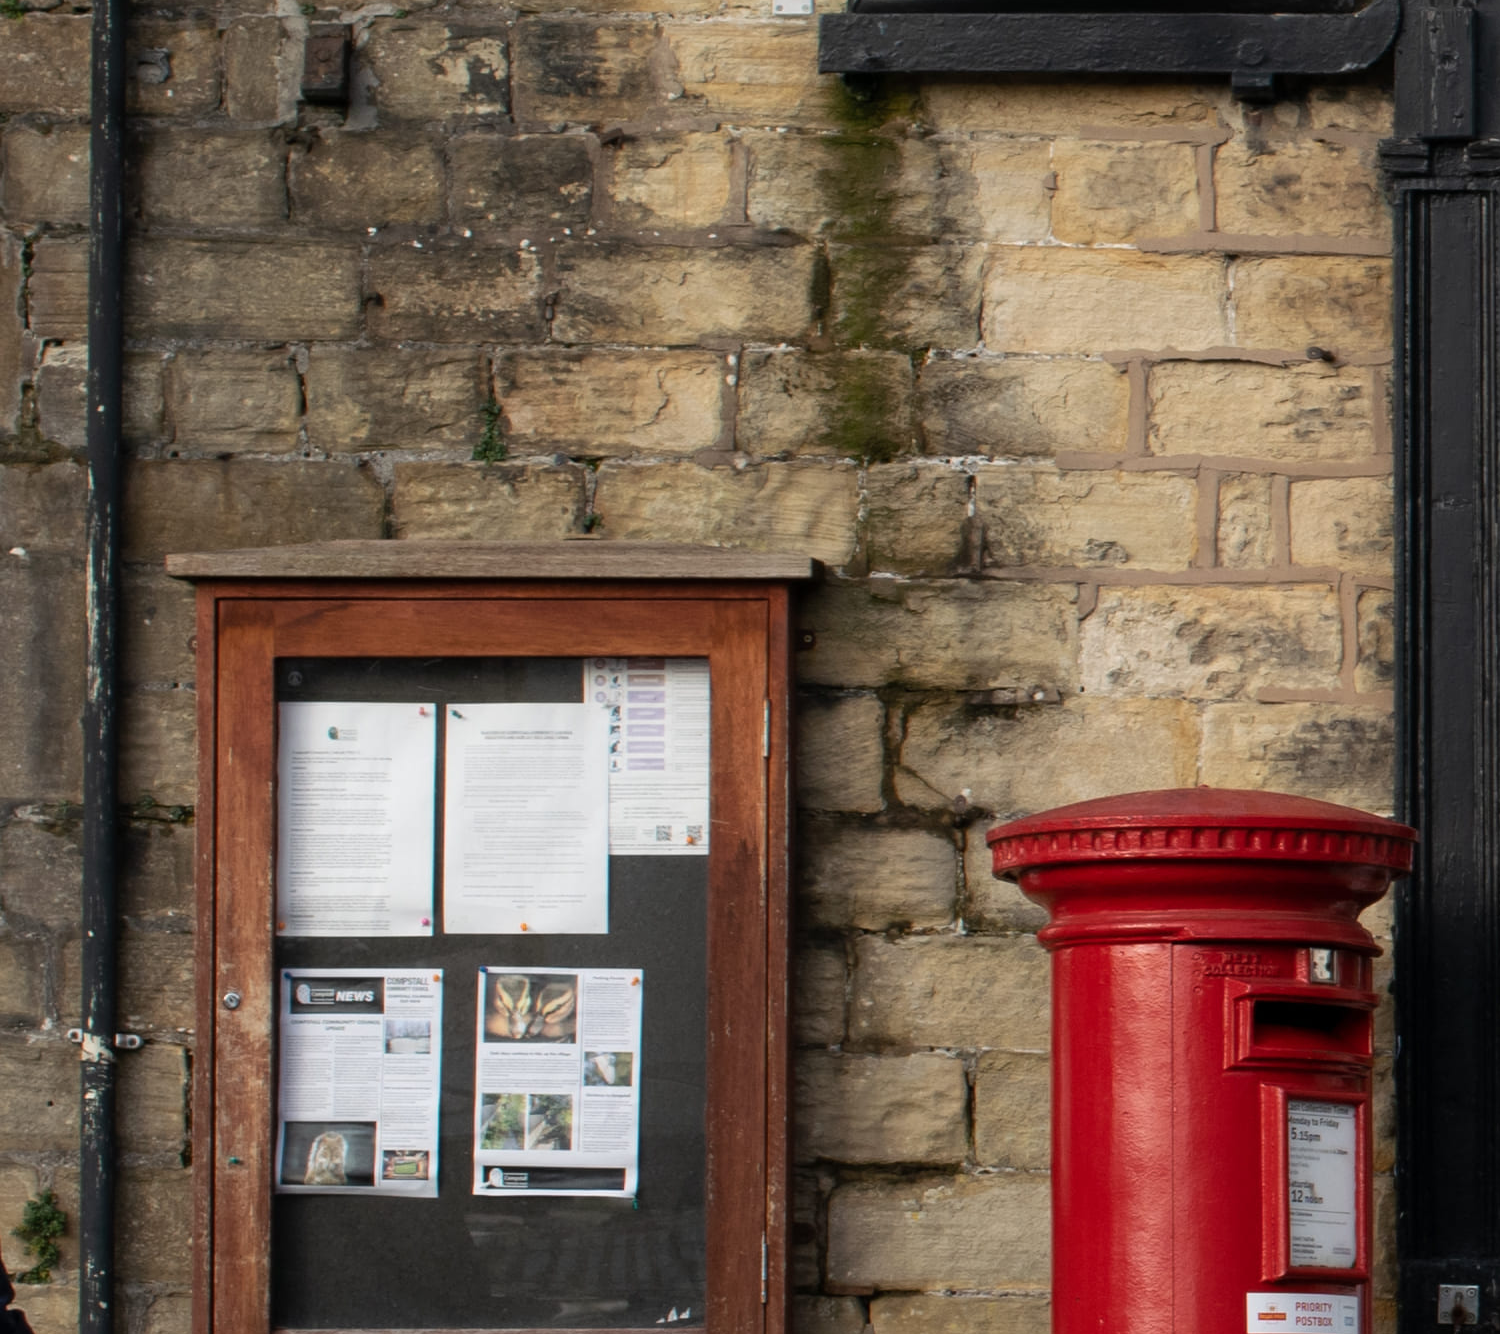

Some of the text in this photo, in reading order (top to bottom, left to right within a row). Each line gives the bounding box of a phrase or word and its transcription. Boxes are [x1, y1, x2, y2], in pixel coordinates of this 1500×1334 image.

[335, 990, 375, 1003] NEWS
[1291, 1189, 1304, 1203] 12
[1295, 1301, 1333, 1313] PRIORITY
[1295, 1316, 1333, 1328] POSTBOX
